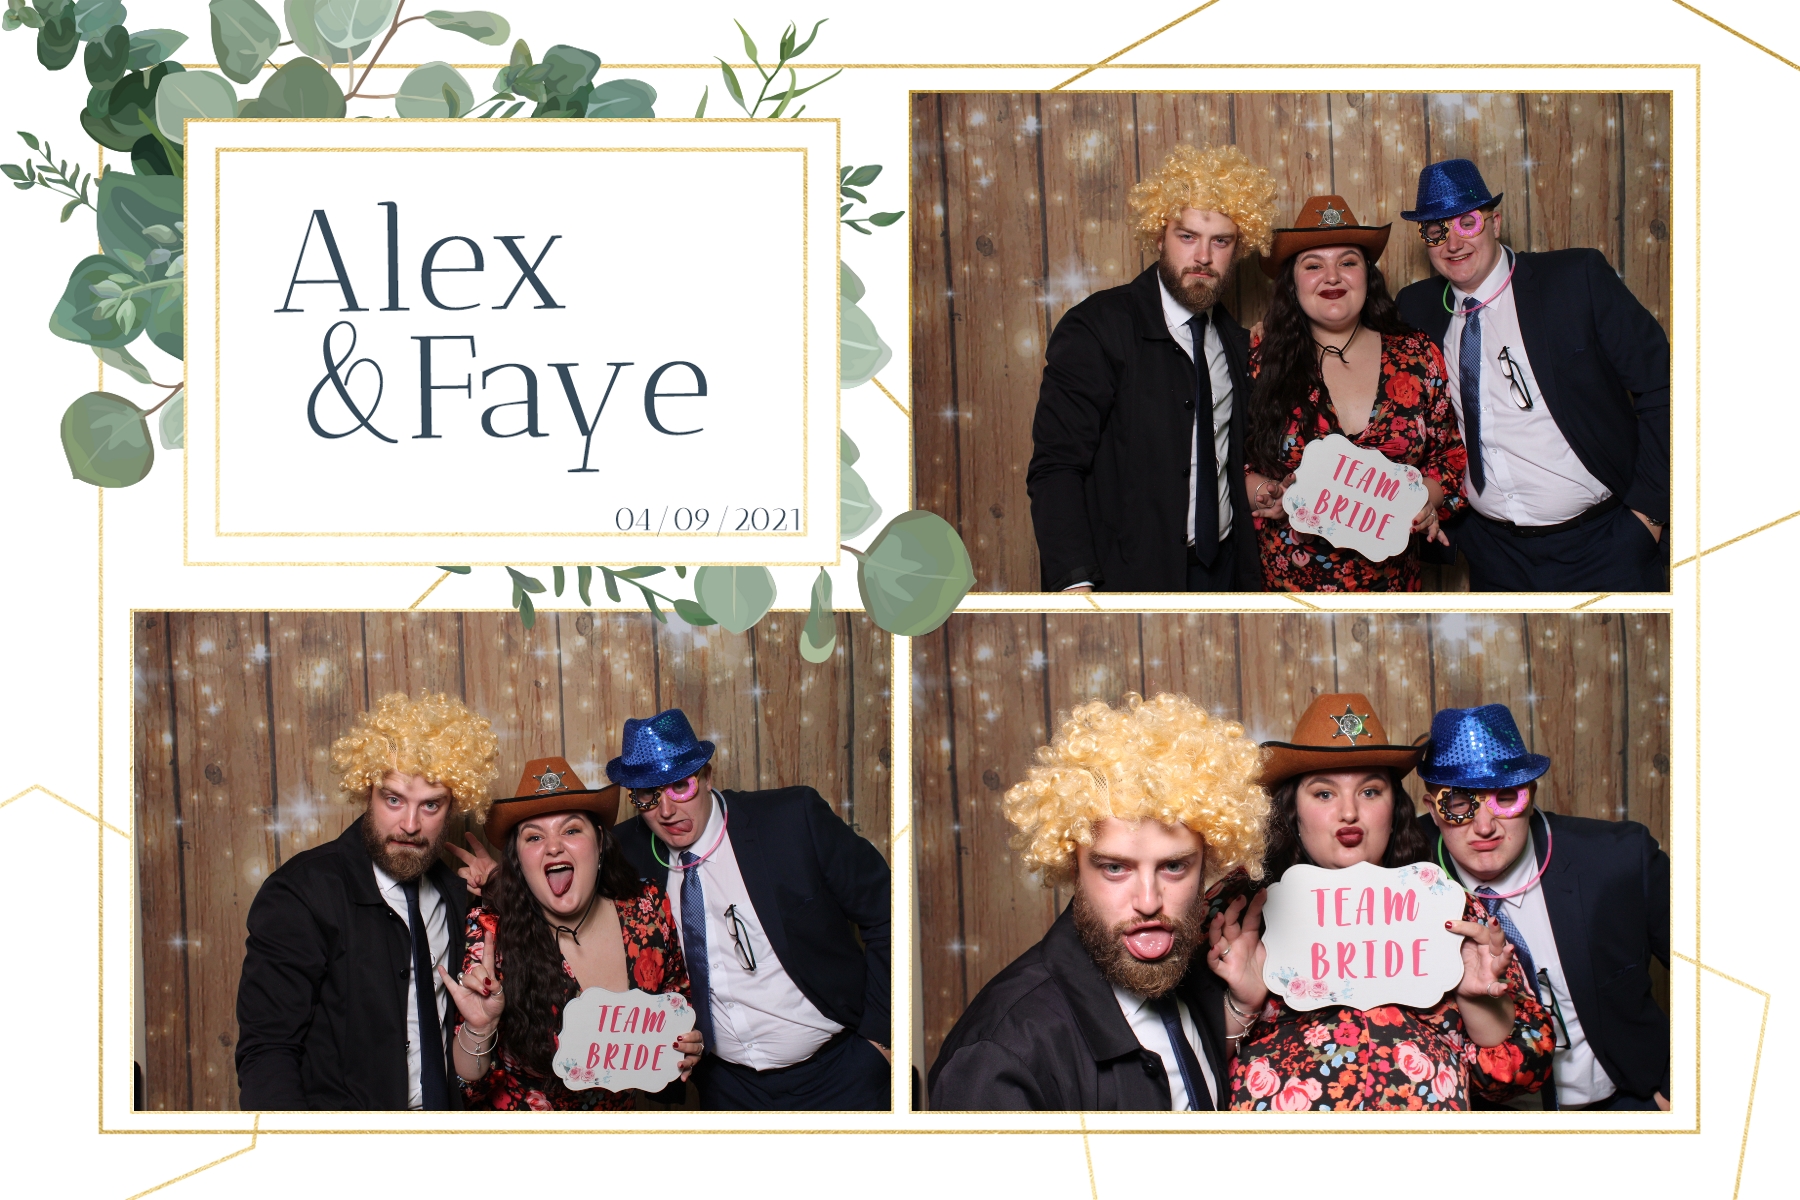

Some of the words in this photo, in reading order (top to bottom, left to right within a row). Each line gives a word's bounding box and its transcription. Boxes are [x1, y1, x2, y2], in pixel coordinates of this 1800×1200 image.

[1333, 454, 1400, 501] TEAM
[1313, 488, 1395, 541] BRIDE
[1311, 887, 1420, 927] TEAM
[1311, 938, 1429, 980] BRIDE
[598, 1005, 667, 1034] TEAM
[586, 1042, 667, 1071] BRIDE
